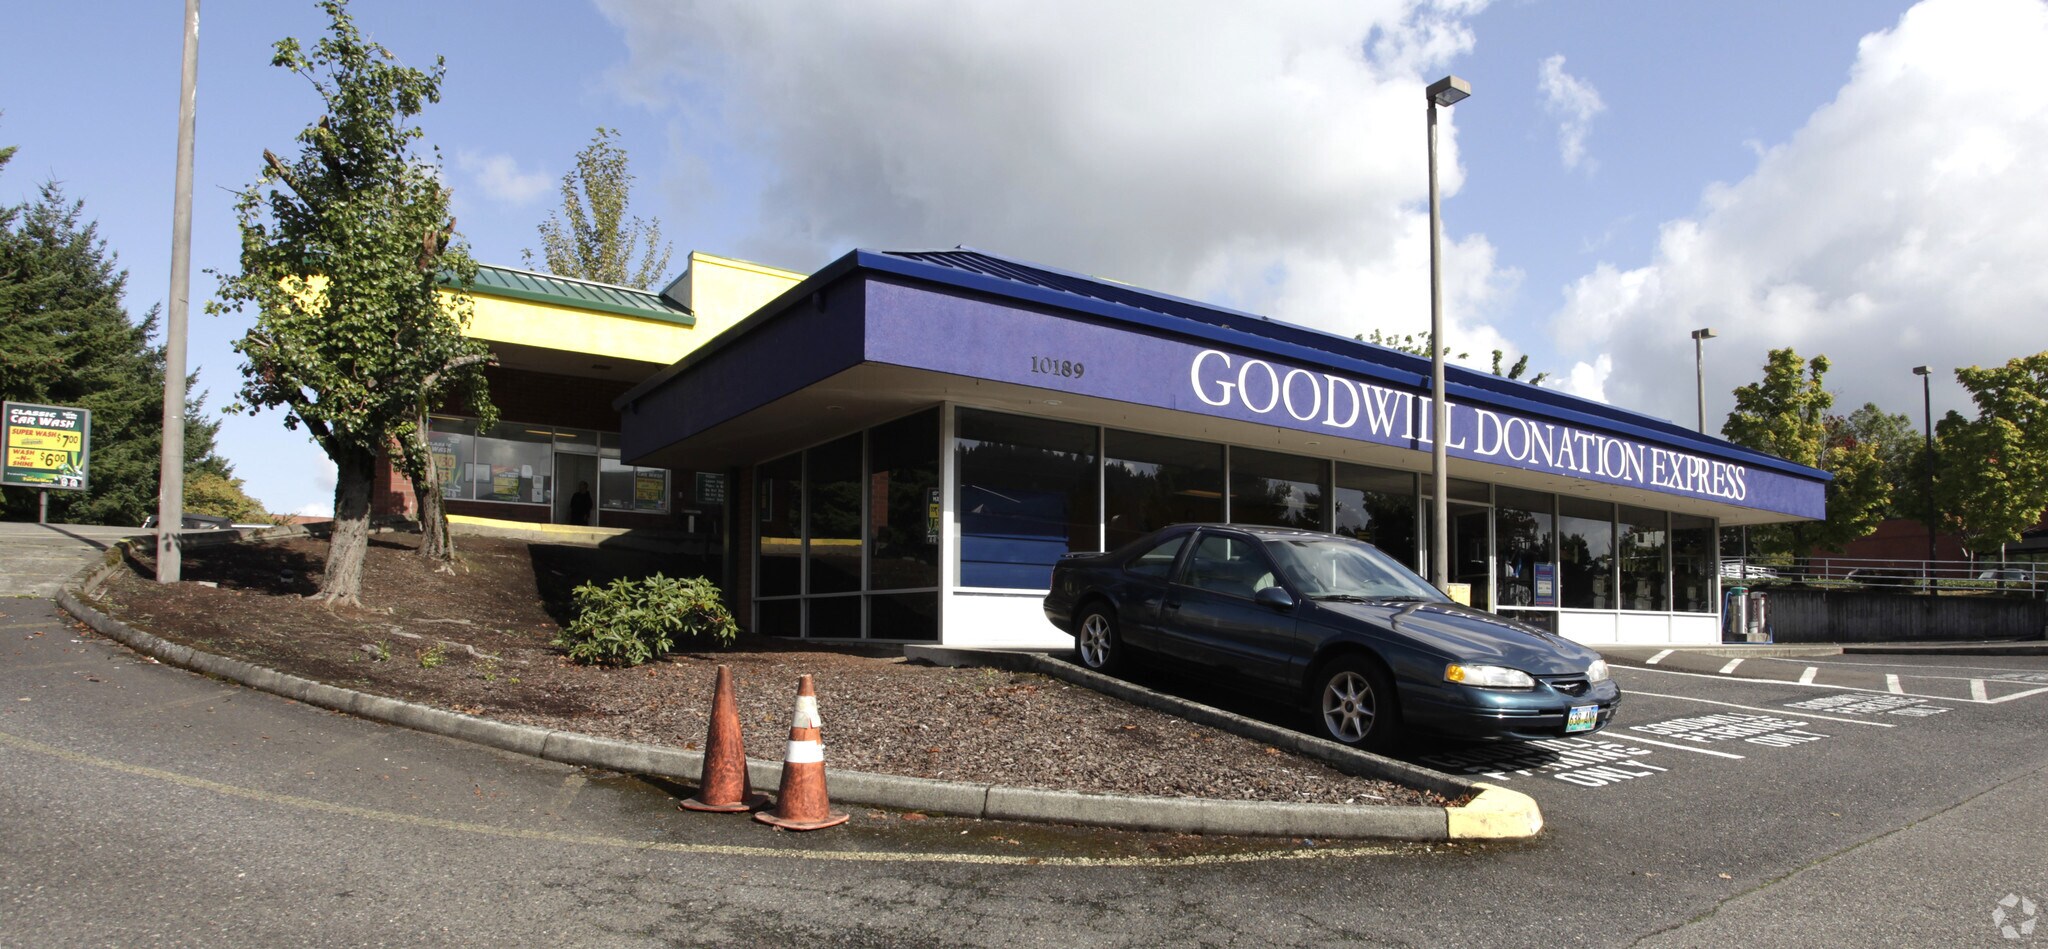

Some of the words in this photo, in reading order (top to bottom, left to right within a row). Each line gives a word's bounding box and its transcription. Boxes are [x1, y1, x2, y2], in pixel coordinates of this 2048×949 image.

[1031, 355, 1084, 379] 10189
[11, 415, 36, 424] CAR
[39, 418, 75, 427] WASH
[12, 409, 56, 418] CLASSIC
[1190, 349, 1466, 449] GOODWILL
[1473, 408, 1646, 484] DONATION
[1650, 447, 1746, 500] EXPRESS
[1745, 729, 1830, 747] ONLY
[1554, 760, 1668, 787] ONLY
